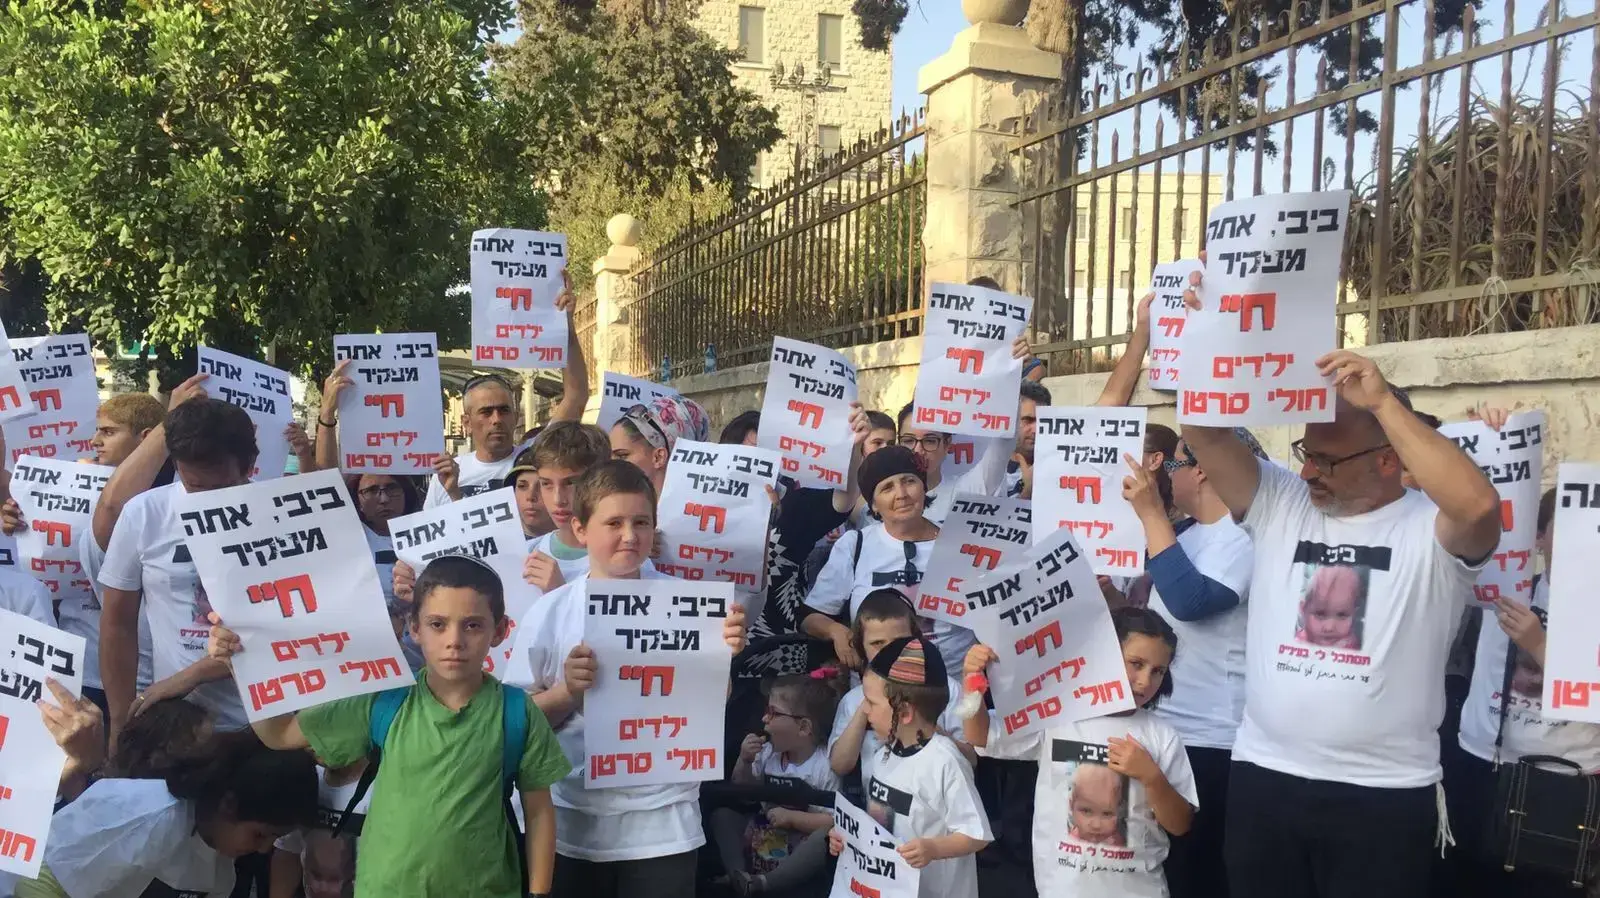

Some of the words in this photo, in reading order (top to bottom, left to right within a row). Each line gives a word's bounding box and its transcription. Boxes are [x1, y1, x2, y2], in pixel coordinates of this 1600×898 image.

[1206, 213, 1256, 241] אתה
[1271, 208, 1339, 238] ביבי,
[474, 238, 514, 253] אתה
[525, 240, 563, 257] ביבי,
[1154, 275, 1183, 288] אתה
[496, 287, 532, 311] חיי
[930, 293, 974, 311] אתה
[983, 299, 1025, 322] ביבי,
[1162, 294, 1185, 309] קיר
[1218, 292, 1276, 332] חיי
[496, 324, 543, 339] ילדים
[46, 343, 87, 359] ביבי,
[337, 345, 381, 360] אתה
[393, 343, 434, 359] ביבי,
[476, 345, 519, 360] סרטן
[529, 346, 563, 361] חולי
[774, 347, 816, 369] אתה
[946, 347, 984, 375] חיי
[201, 357, 242, 381] אתה
[1213, 353, 1294, 379] ילדים
[252, 372, 287, 396] ביבי,
[605, 381, 641, 400] אתה
[940, 386, 990, 405] ילדים
[364, 394, 404, 417] חיי
[1182, 390, 1250, 415] סרטן
[1267, 387, 1327, 412] חולי
[787, 400, 824, 429] חיי
[917, 406, 961, 425] סרטן
[972, 412, 1010, 430] חולי
[28, 421, 78, 439] ילדים
[1039, 418, 1085, 435] אתה
[1096, 419, 1140, 437] ביבי,
[66, 439, 95, 452] ולי
[366, 431, 418, 446] ילדים
[780, 436, 825, 457] ילדים
[346, 454, 392, 468] סרטן
[672, 449, 719, 466] אתה
[727, 455, 773, 478] ביבי,
[15, 465, 61, 484] אתה
[808, 464, 842, 484] חולי
[1059, 476, 1101, 504] חיי
[272, 486, 345, 523] ביבי,
[952, 500, 1000, 515] אתה
[180, 503, 252, 536] אתה
[461, 502, 513, 533] ביבי,
[683, 502, 727, 534] חיי
[32, 520, 70, 547] חיי
[395, 520, 446, 550] אתה
[31, 557, 81, 573] לדים
[679, 544, 734, 563] ילדים
[960, 544, 1001, 570] חיי
[1036, 541, 1079, 584] ביבי,
[1096, 548, 1138, 567] חולי
[246, 574, 318, 618] חיי
[966, 573, 1021, 610] אתה
[588, 595, 651, 616] אתה
[667, 596, 727, 619] ביבי,
[918, 594, 967, 617] סרטן
[271, 632, 350, 662] ילדים
[1015, 621, 1063, 657] חיי
[11, 634, 75, 676] ביבי,
[339, 657, 402, 682] חולי
[1024, 657, 1087, 696] ילדים
[248, 669, 326, 711] סרטן
[619, 666, 675, 697] חיי
[1073, 681, 1125, 706] חולי
[1003, 696, 1062, 735] סרטן
[620, 716, 687, 740] ילדים
[591, 752, 652, 780] סרטן
[666, 747, 716, 770] חולי
